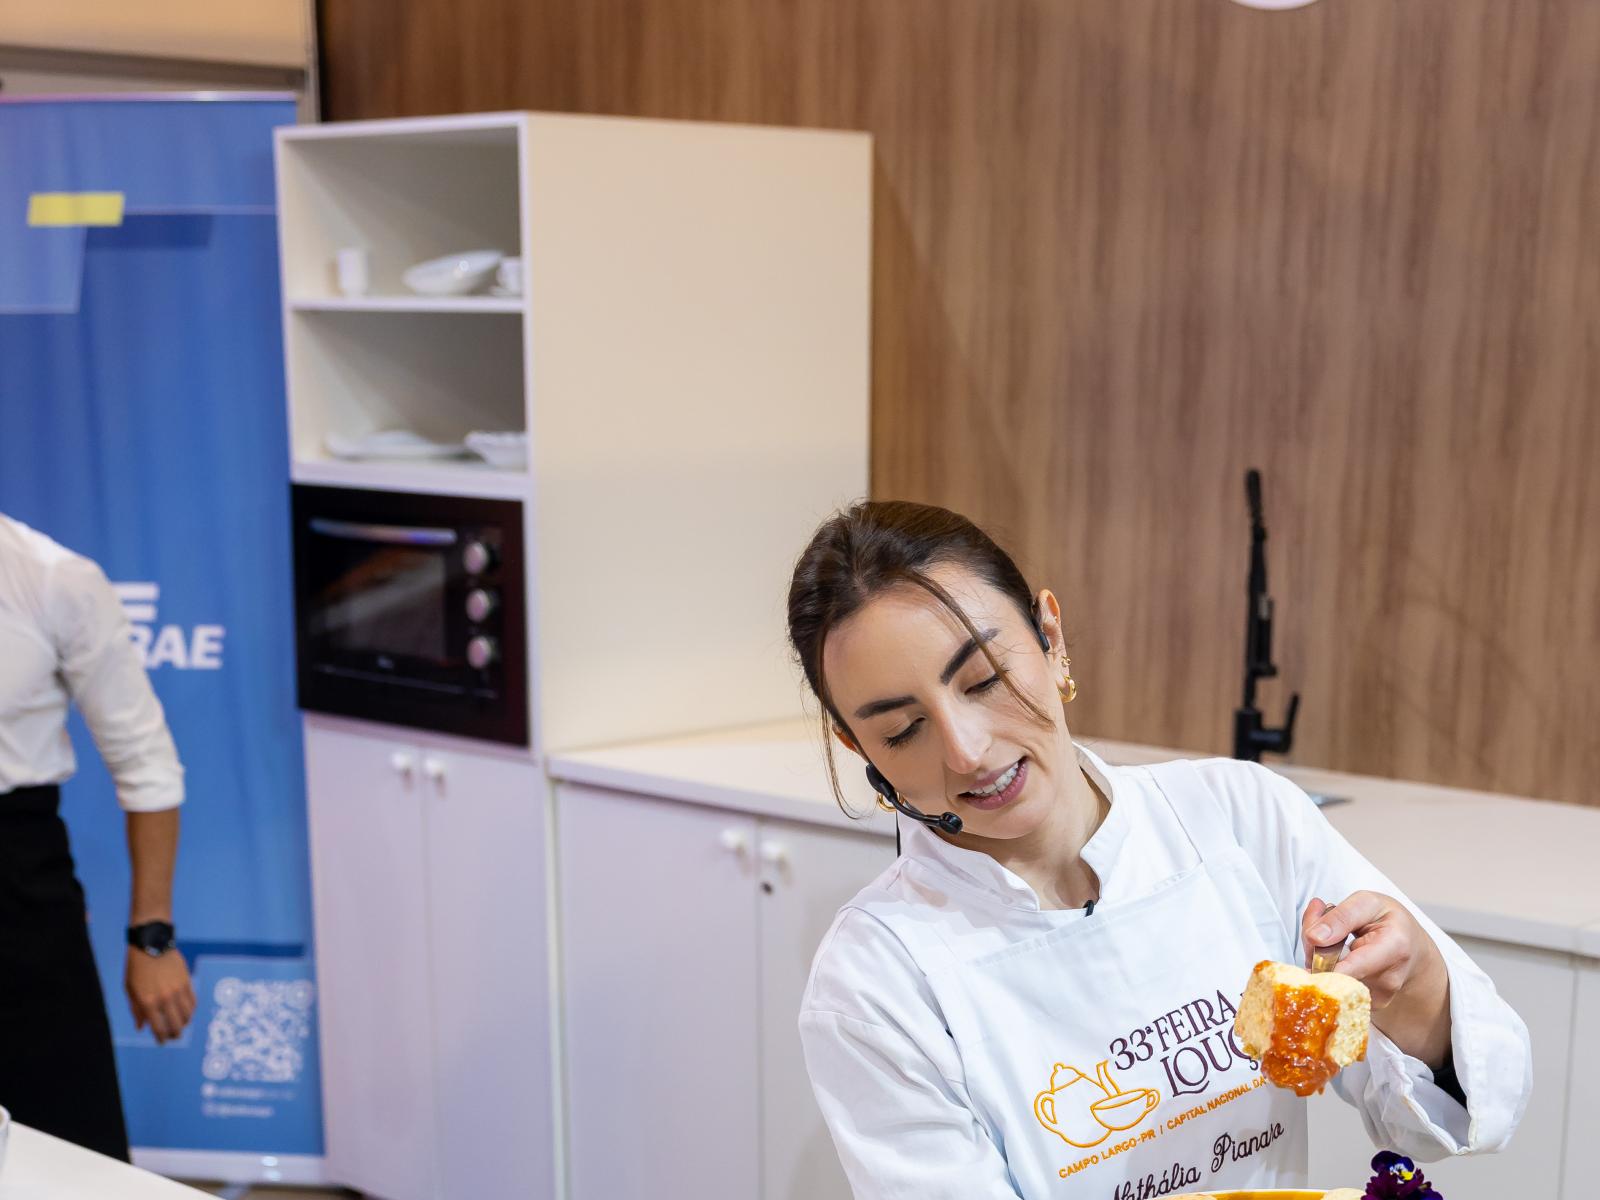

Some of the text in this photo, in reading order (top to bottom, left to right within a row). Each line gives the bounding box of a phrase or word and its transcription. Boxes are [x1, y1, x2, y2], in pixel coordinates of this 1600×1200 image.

[128, 624, 226, 670] RAE
[1152, 989, 1237, 1052] FEIRA
[1160, 1024, 1259, 1097] LOUÇ
[1059, 1155, 1099, 1179] CAMPO
[1167, 1106, 1207, 1130] CAPITAL
[1207, 1083, 1251, 1110] NACIONAL
